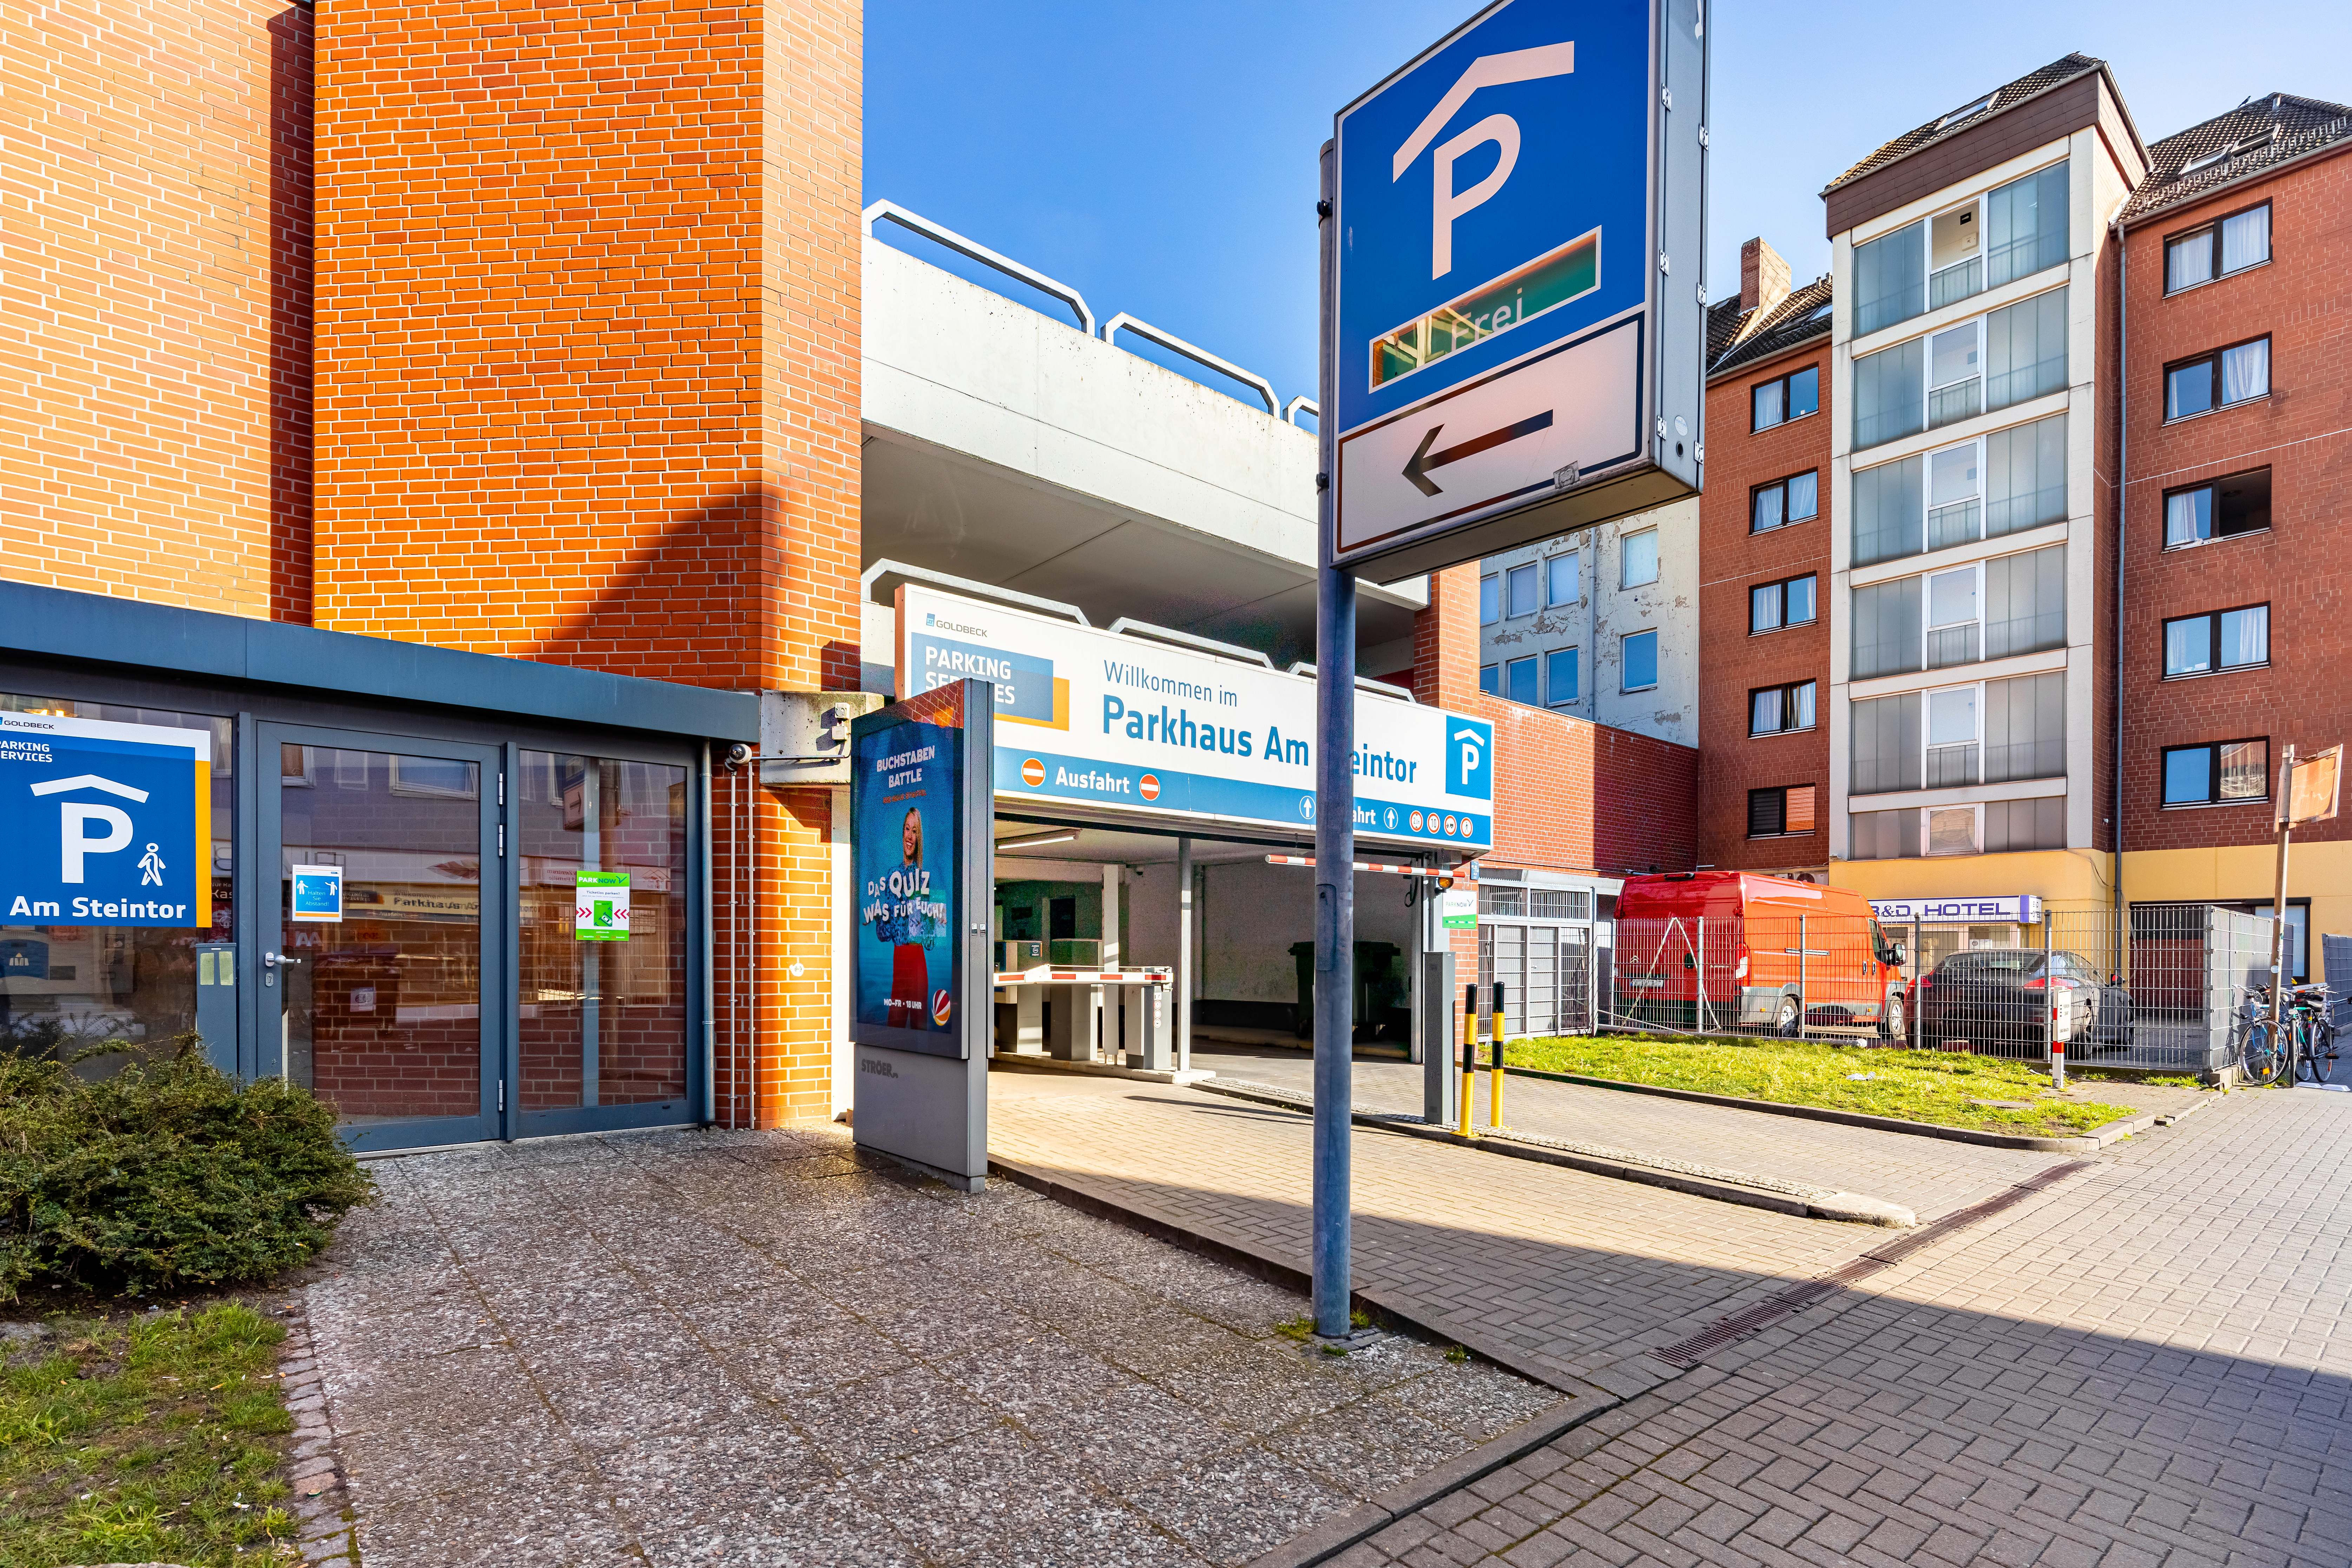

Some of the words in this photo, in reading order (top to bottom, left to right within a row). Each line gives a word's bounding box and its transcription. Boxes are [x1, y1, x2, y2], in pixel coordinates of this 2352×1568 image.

[1432, 113, 1521, 280] P
[1450, 288, 1523, 352] Frei
[936, 620, 988, 638] GOLDBECK
[925, 646, 1011, 680] PARKING
[925, 671, 1015, 704] SEES
[1104, 659, 1212, 702] Willkommen
[1219, 685, 1237, 707] im
[4, 720, 55, 730] GOLDBECK
[1103, 694, 1252, 757] Parkhaus
[1264, 726, 1309, 766] Am
[1353, 743, 1417, 783] eintor
[0, 740, 50, 752] ARKING
[0, 750, 53, 763] ERVICES
[877, 745, 935, 772] BUCHSTABEN
[1462, 743, 1480, 785] P
[889, 768, 922, 788] BATTLE
[1055, 766, 1130, 794] Ausfahrt
[1353, 805, 1376, 825] ahrt
[1431, 818, 1436, 828] 10
[61, 802, 134, 884] P
[868, 876, 886, 898] DAS
[889, 868, 930, 899] QUIZ
[9, 895, 60, 917] Am
[72, 897, 186, 919] Steintor
[863, 898, 889, 924] WAS
[894, 901, 913, 917] FÜR
[916, 896, 944, 918] EUCH!
[1924, 903, 2010, 916] HOTEL
[906, 1000, 911, 1009] 18
[911, 1000, 922, 1010] UHR
[861, 1058, 892, 1077] STRÖER
